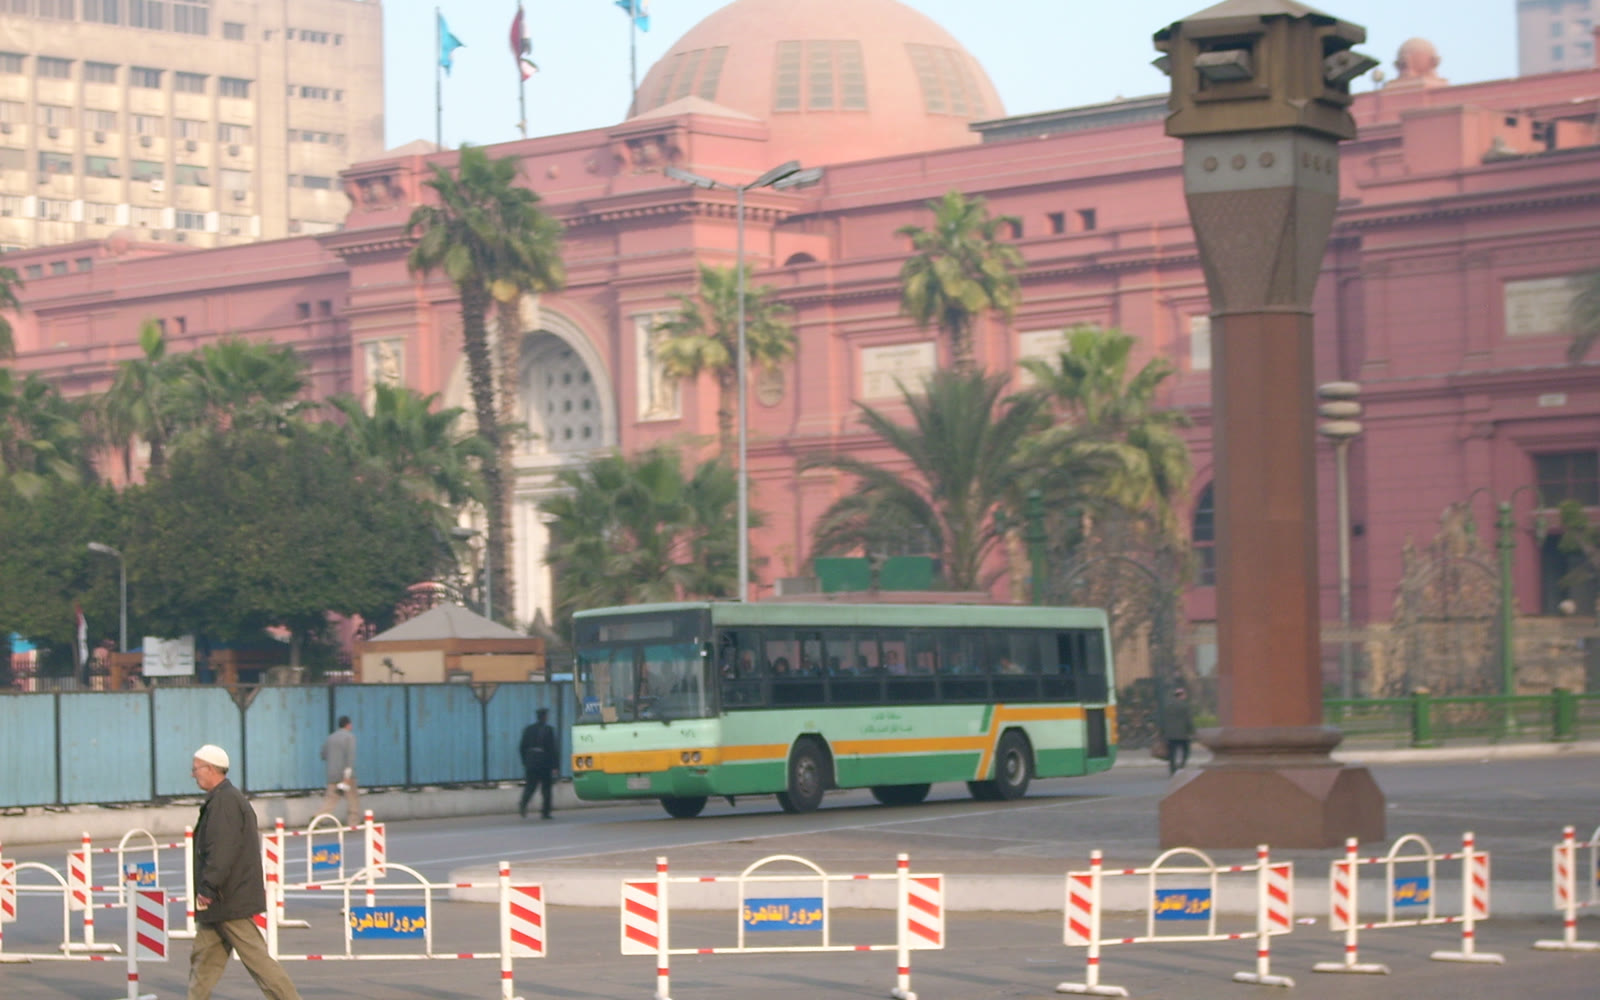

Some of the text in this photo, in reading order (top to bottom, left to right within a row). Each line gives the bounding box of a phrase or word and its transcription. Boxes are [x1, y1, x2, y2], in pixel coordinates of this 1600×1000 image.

[349, 911, 425, 932] مرور القاهرة
[743, 905, 822, 924] مرور القاهرة
